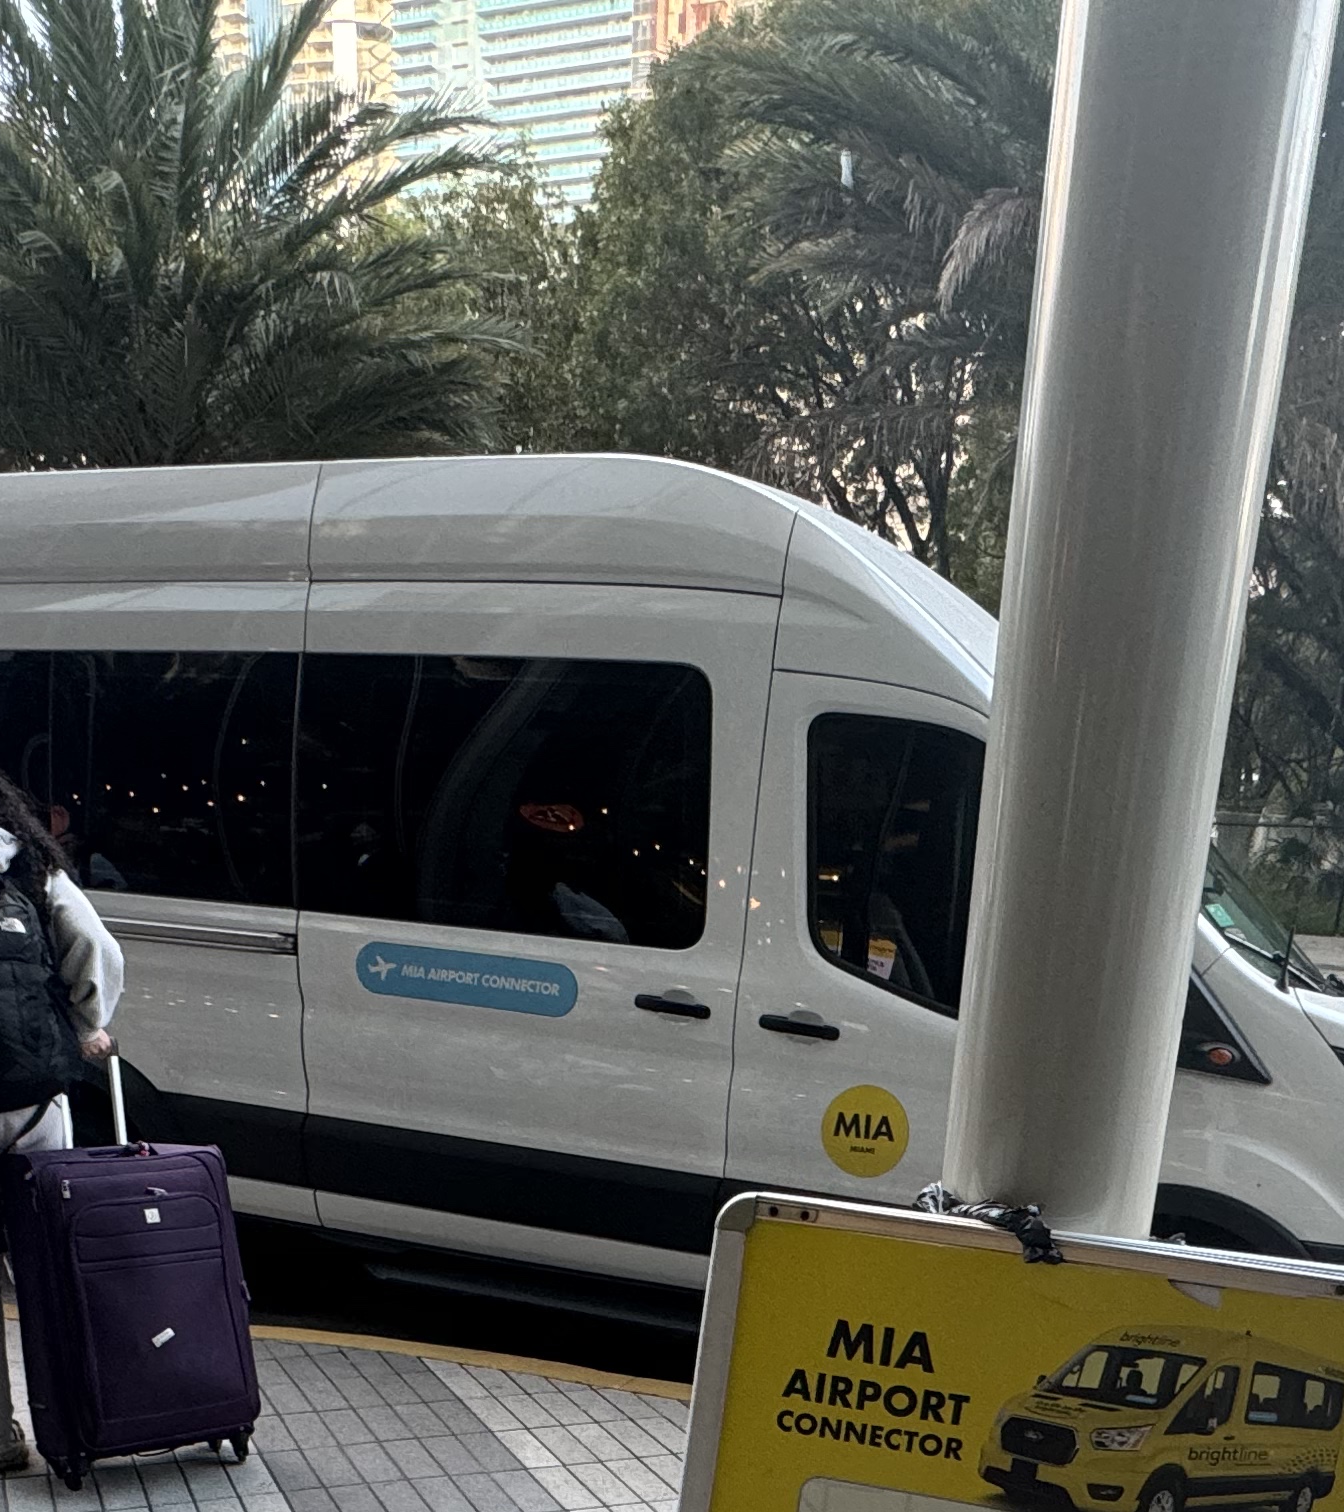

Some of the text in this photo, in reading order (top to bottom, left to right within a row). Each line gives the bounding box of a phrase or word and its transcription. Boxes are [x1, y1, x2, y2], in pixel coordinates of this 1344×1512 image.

[400, 963, 561, 997] MIA AIRPORT CONNECTOR
[833, 1111, 895, 1142] MIA
[826, 1318, 935, 1374] MIA
[1119, 1331, 1181, 1347] brightline
[781, 1368, 971, 1426] AIRPORT
[776, 1409, 964, 1461] CONNECTOR
[1187, 1446, 1269, 1467] brightline
